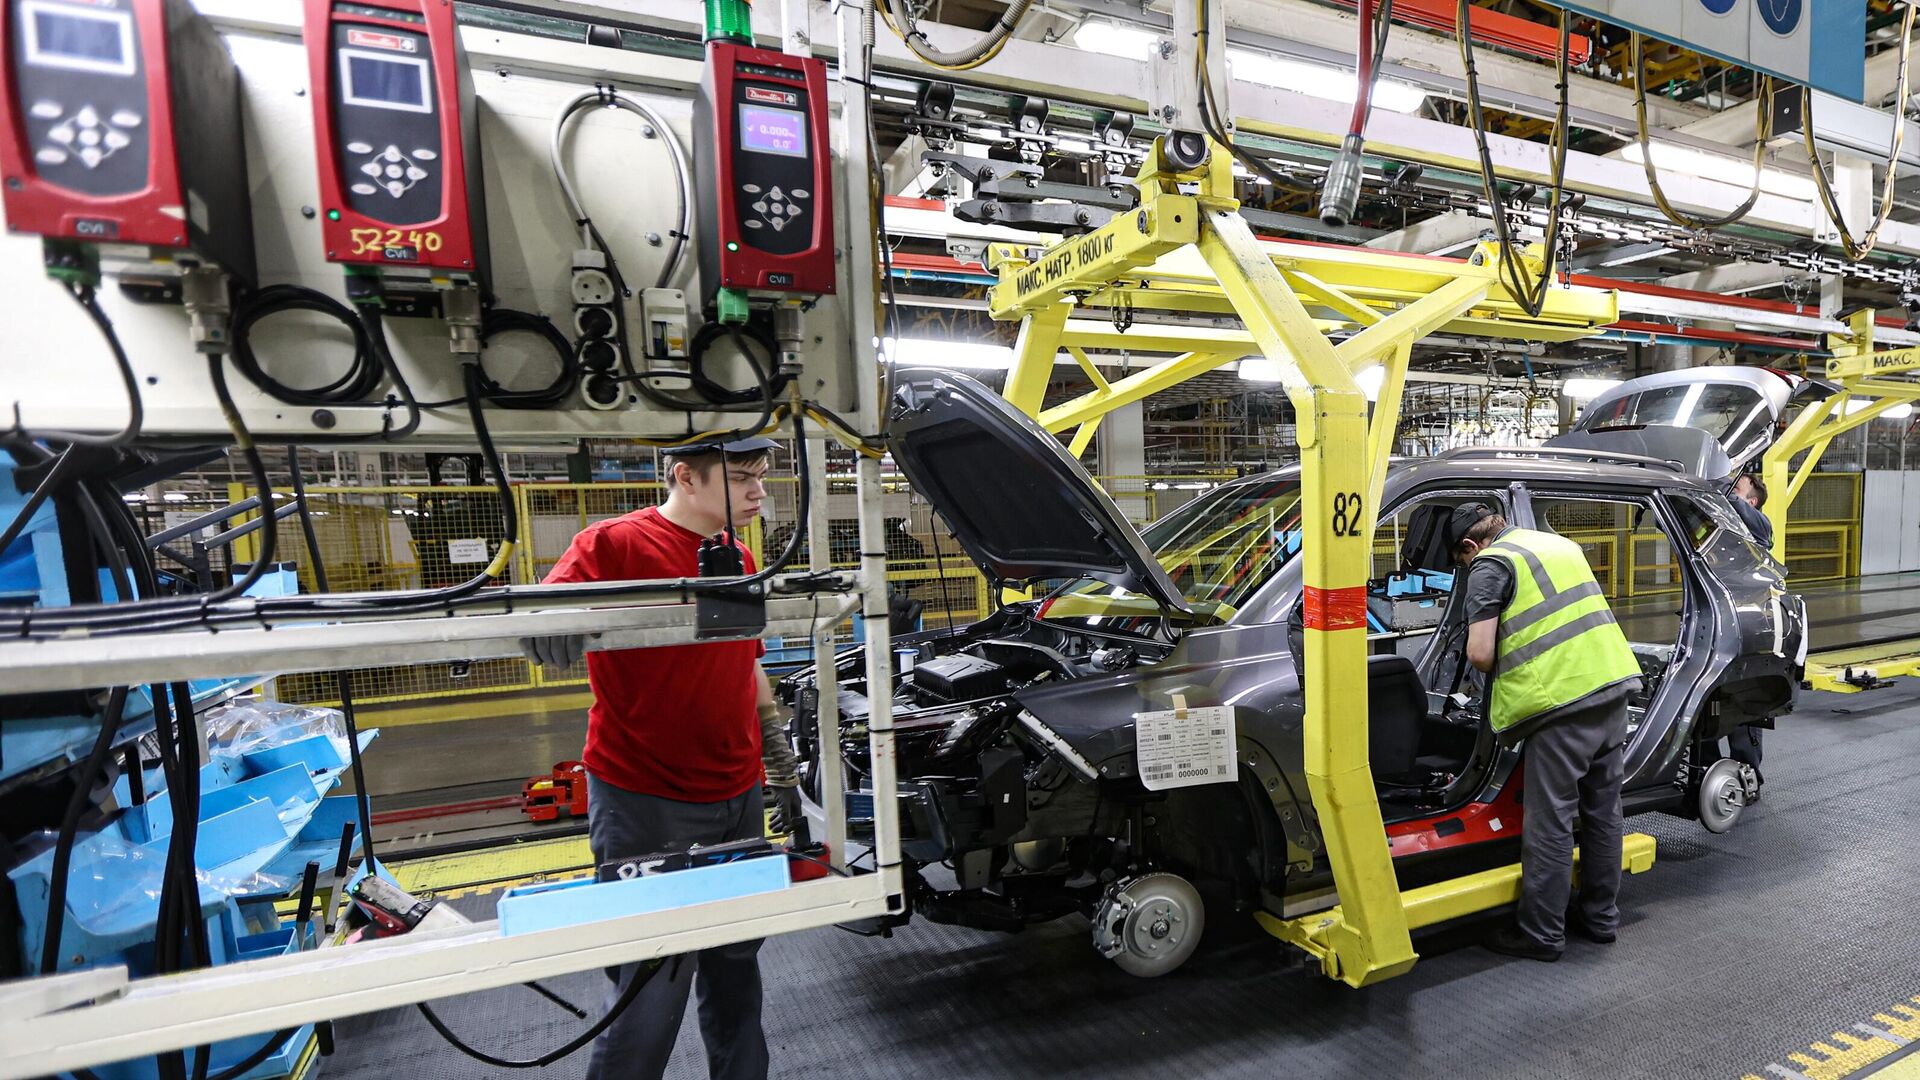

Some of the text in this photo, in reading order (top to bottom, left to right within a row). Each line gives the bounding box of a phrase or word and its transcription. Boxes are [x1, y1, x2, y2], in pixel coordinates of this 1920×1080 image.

[349, 228, 443, 255] 52240
[1016, 266, 1045, 298] МАКС.
[1045, 251, 1075, 283] НАГР.
[1076, 235, 1101, 267] 1800
[1873, 352, 1916, 369] МАКС.
[1332, 491, 1363, 537] 82
[1178, 768, 1209, 778] 0000000
